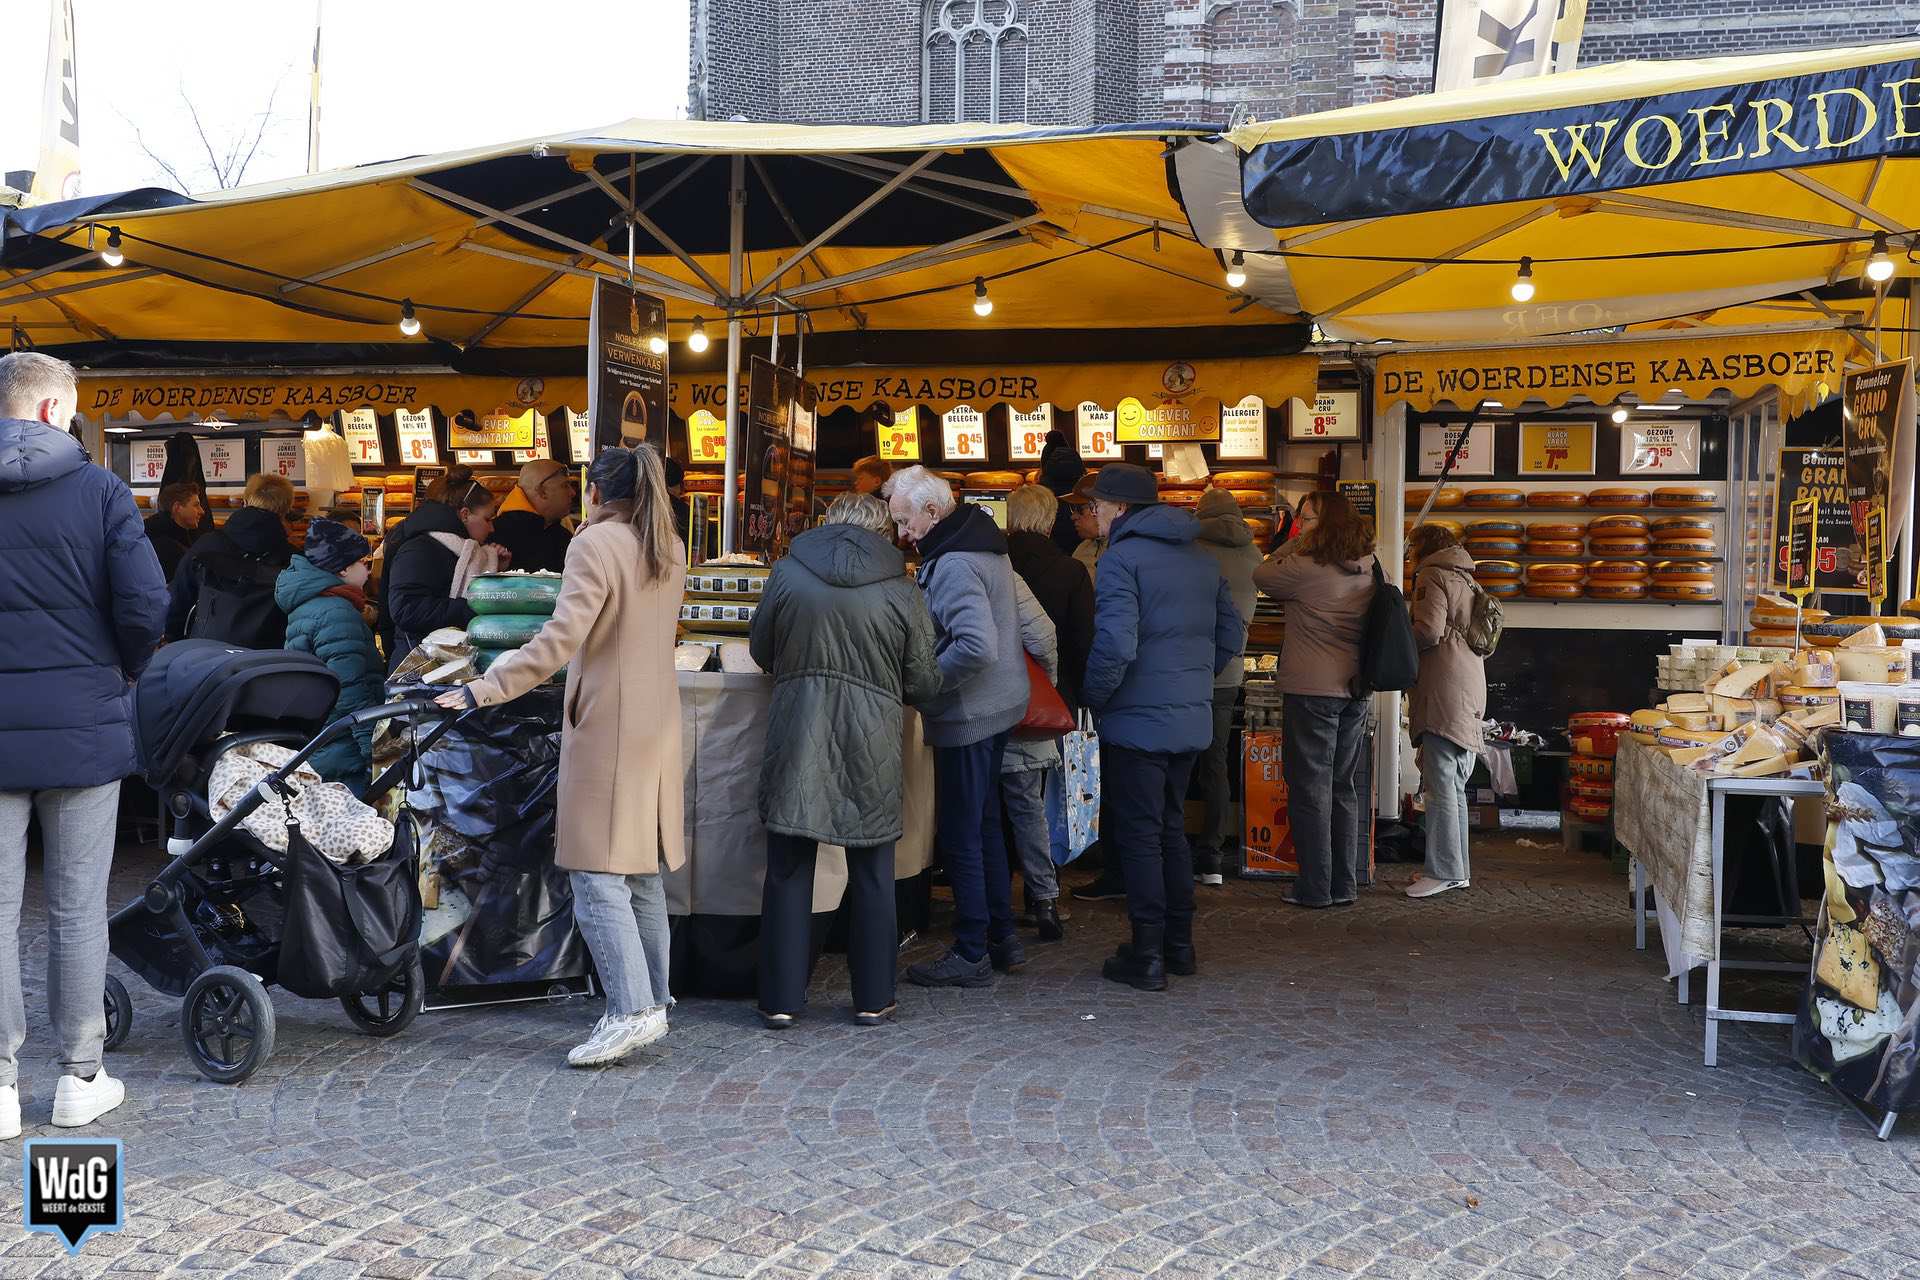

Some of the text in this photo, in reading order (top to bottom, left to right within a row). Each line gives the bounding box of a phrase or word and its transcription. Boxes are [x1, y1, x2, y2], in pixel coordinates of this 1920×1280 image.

[1533, 76, 1920, 183] WOERDE
[607, 347, 661, 371] VERWENKAAS
[1383, 349, 1838, 395] DE WOERDENSE KAASBOER
[1855, 370, 1892, 391] Bemmelaer
[92, 382, 418, 410] DE WOERDENSE KAASBOER
[872, 375, 1040, 400] KAASBOER
[952, 406, 974, 414] EXTRA
[1853, 389, 1888, 416] GRAND
[947, 415, 978, 423] BELEGEN
[1014, 413, 1046, 421] BELEGEN
[1145, 407, 1191, 421] LIEVER
[1222, 409, 1260, 417] ALLERGIE?
[483, 419, 510, 431] EVER
[1139, 423, 1197, 437] CONTANT
[1314, 415, 1337, 435] 8,95
[1646, 428, 1674, 436] GEZOND
[1858, 415, 1877, 440] CRU
[883, 440, 891, 448] 10
[957, 433, 983, 455] 8,45
[1662, 435, 1674, 443] VET
[358, 439, 378, 460] 7,95
[411, 439, 433, 460] 8,95
[1250, 826, 1271, 843] 10
